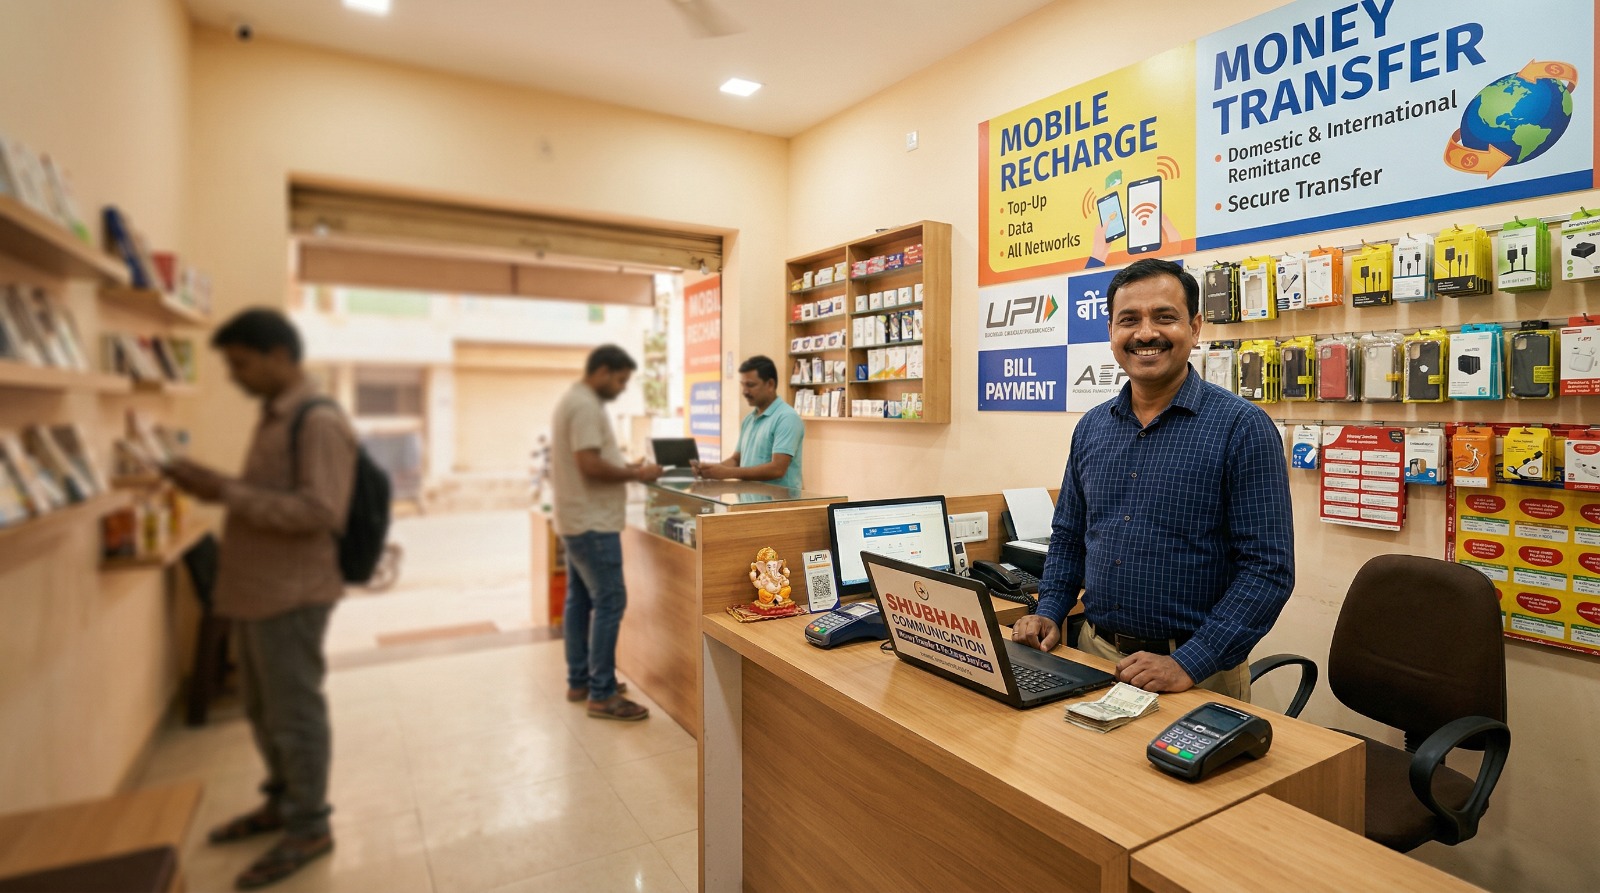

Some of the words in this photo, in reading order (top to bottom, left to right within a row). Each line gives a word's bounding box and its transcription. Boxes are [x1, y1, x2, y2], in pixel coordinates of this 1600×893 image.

[1214, 0, 1394, 91] MONEY
[1212, 22, 1487, 136] TRANSFER
[1000, 91, 1109, 156] MOBILE
[1228, 131, 1303, 163] Domestic
[1308, 126, 1322, 143] &
[1327, 89, 1458, 139] International
[1001, 116, 1158, 192] RECHARGE
[1228, 151, 1321, 183] Remittance
[1007, 195, 1047, 216] Top-Up
[1228, 188, 1290, 213] Secure
[1296, 167, 1383, 199] Transfer
[1007, 245, 1022, 259] All
[1030, 232, 1081, 255] Networks
[1008, 221, 1033, 237] Data
[986, 295, 1045, 329] UPI
[1004, 357, 1037, 377] BILL
[985, 380, 1057, 400] PAYMENT
[885, 593, 981, 639] SHUBHAM
[892, 614, 987, 655] COMMUNICATION
